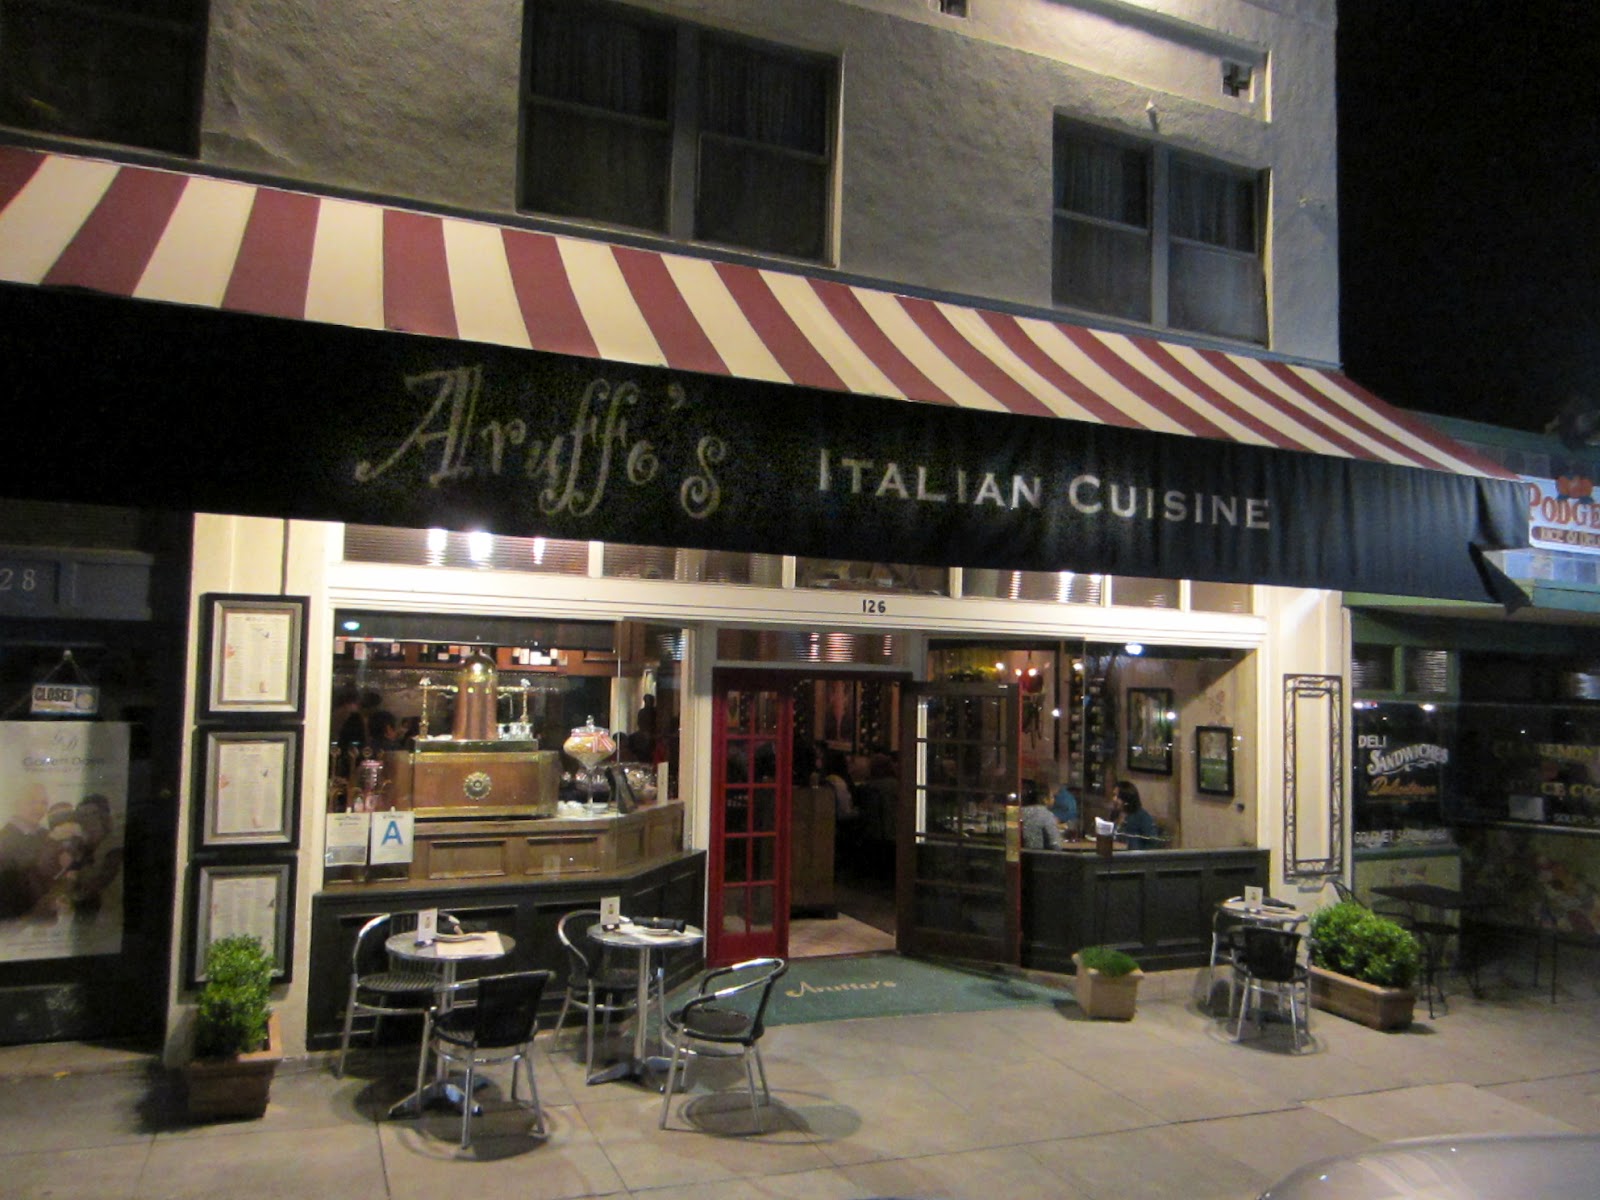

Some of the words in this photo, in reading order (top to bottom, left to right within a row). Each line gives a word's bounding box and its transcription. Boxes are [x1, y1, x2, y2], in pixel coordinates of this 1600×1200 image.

[354, 364, 728, 520] Aruffo's
[819, 447, 1042, 510] ITALIAN
[1068, 474, 1271, 530] CUISINE
[862, 599, 886, 614] 126
[1357, 734, 1387, 749] DELI
[380, 819, 404, 847] A
